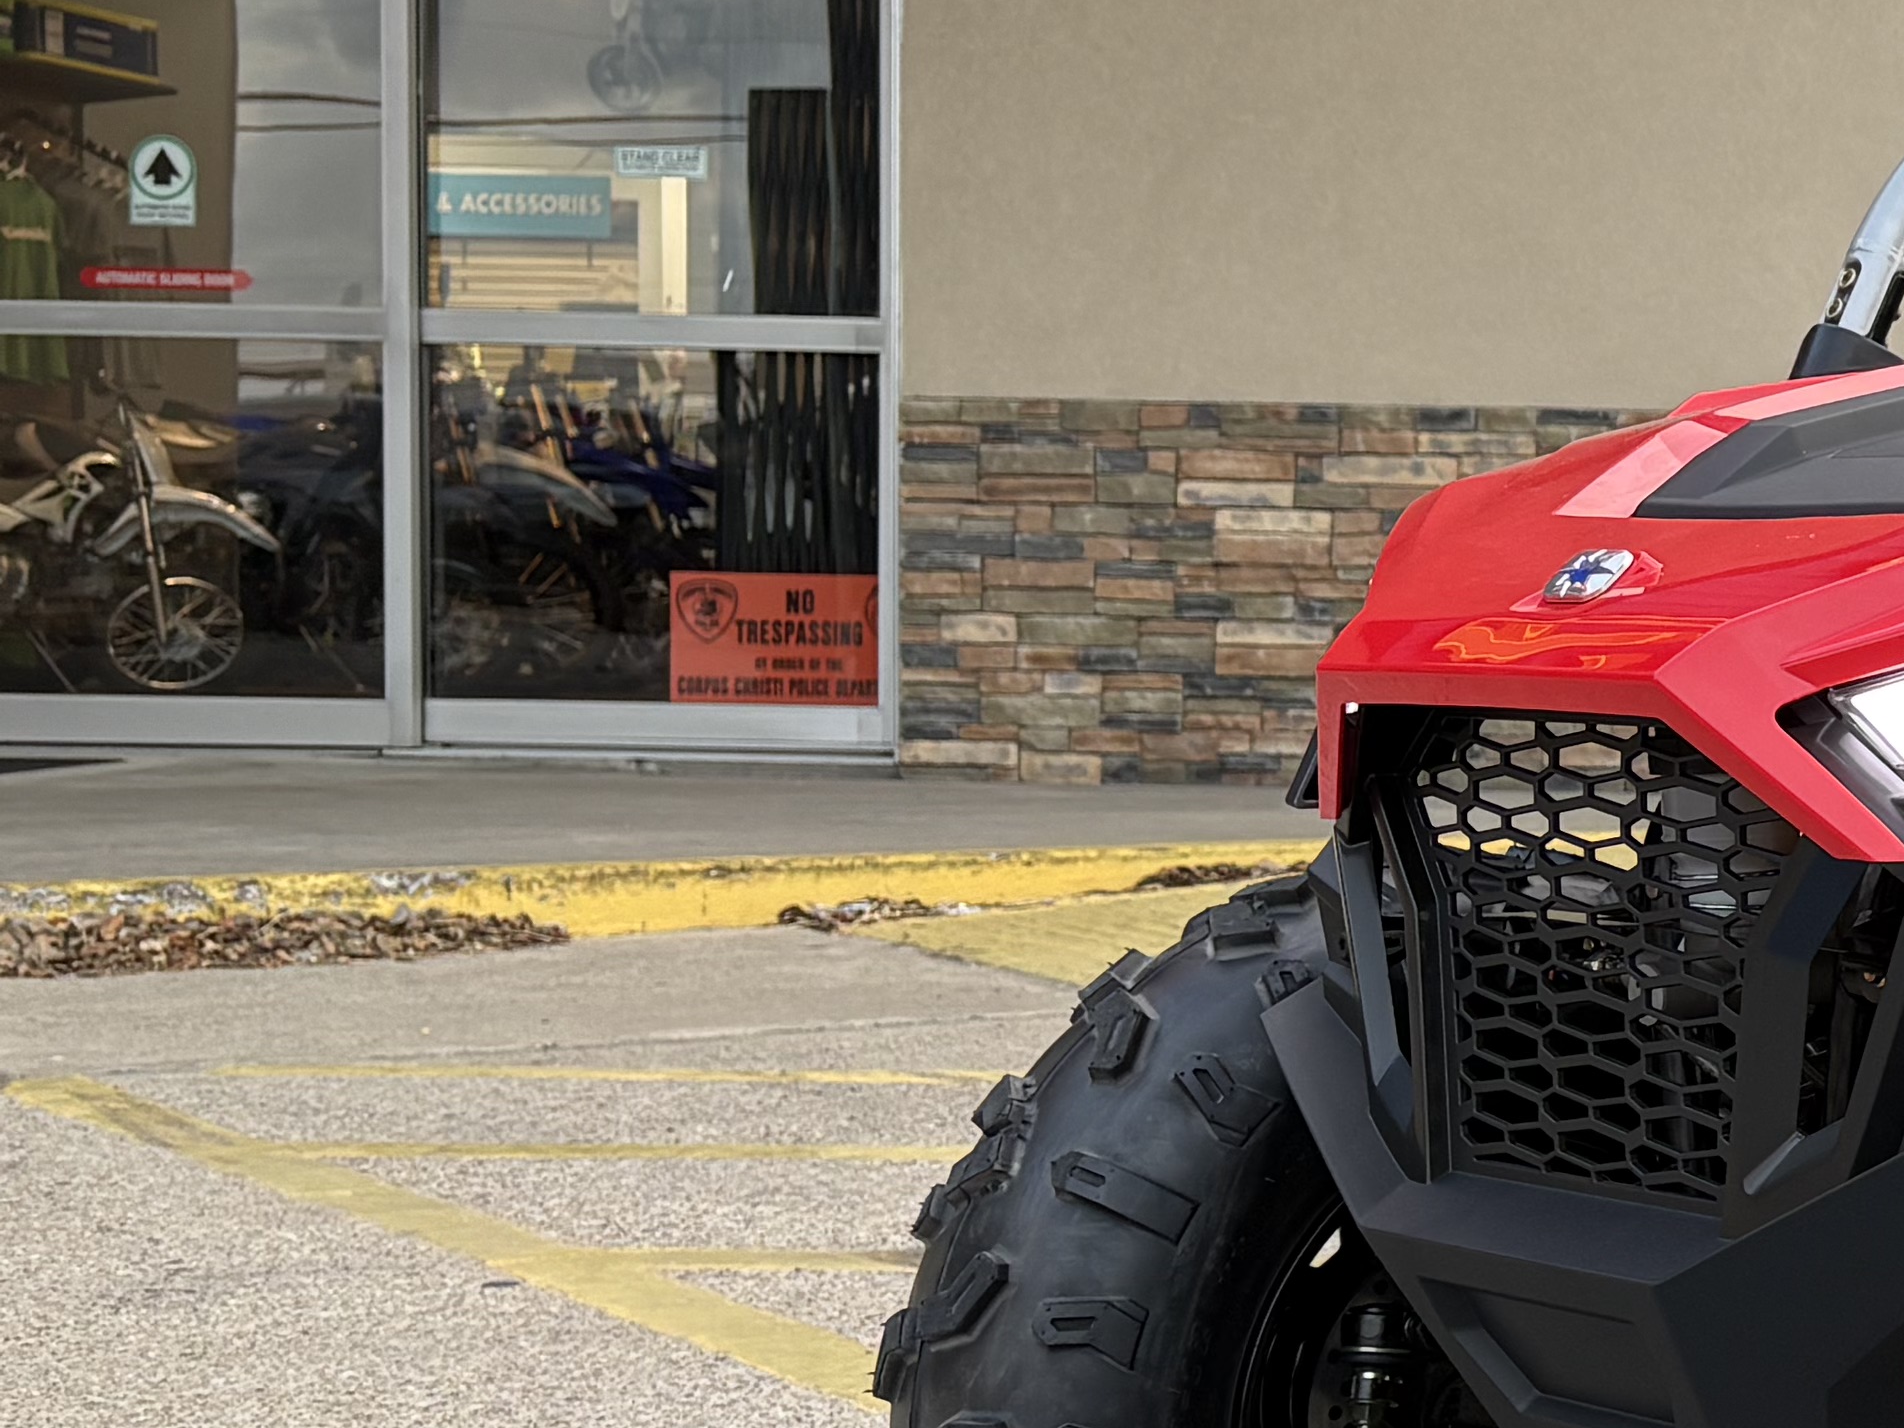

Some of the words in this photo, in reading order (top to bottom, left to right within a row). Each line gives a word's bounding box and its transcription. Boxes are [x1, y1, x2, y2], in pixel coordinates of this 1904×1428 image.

[437, 192, 452, 214] &
[459, 193, 602, 217] ACCESSORIES
[785, 588, 815, 615] NO
[736, 619, 864, 647] TRESPASSING
[677, 675, 729, 695] CORPUS
[734, 676, 785, 696] CHRISTI
[788, 677, 829, 697] POLICE
